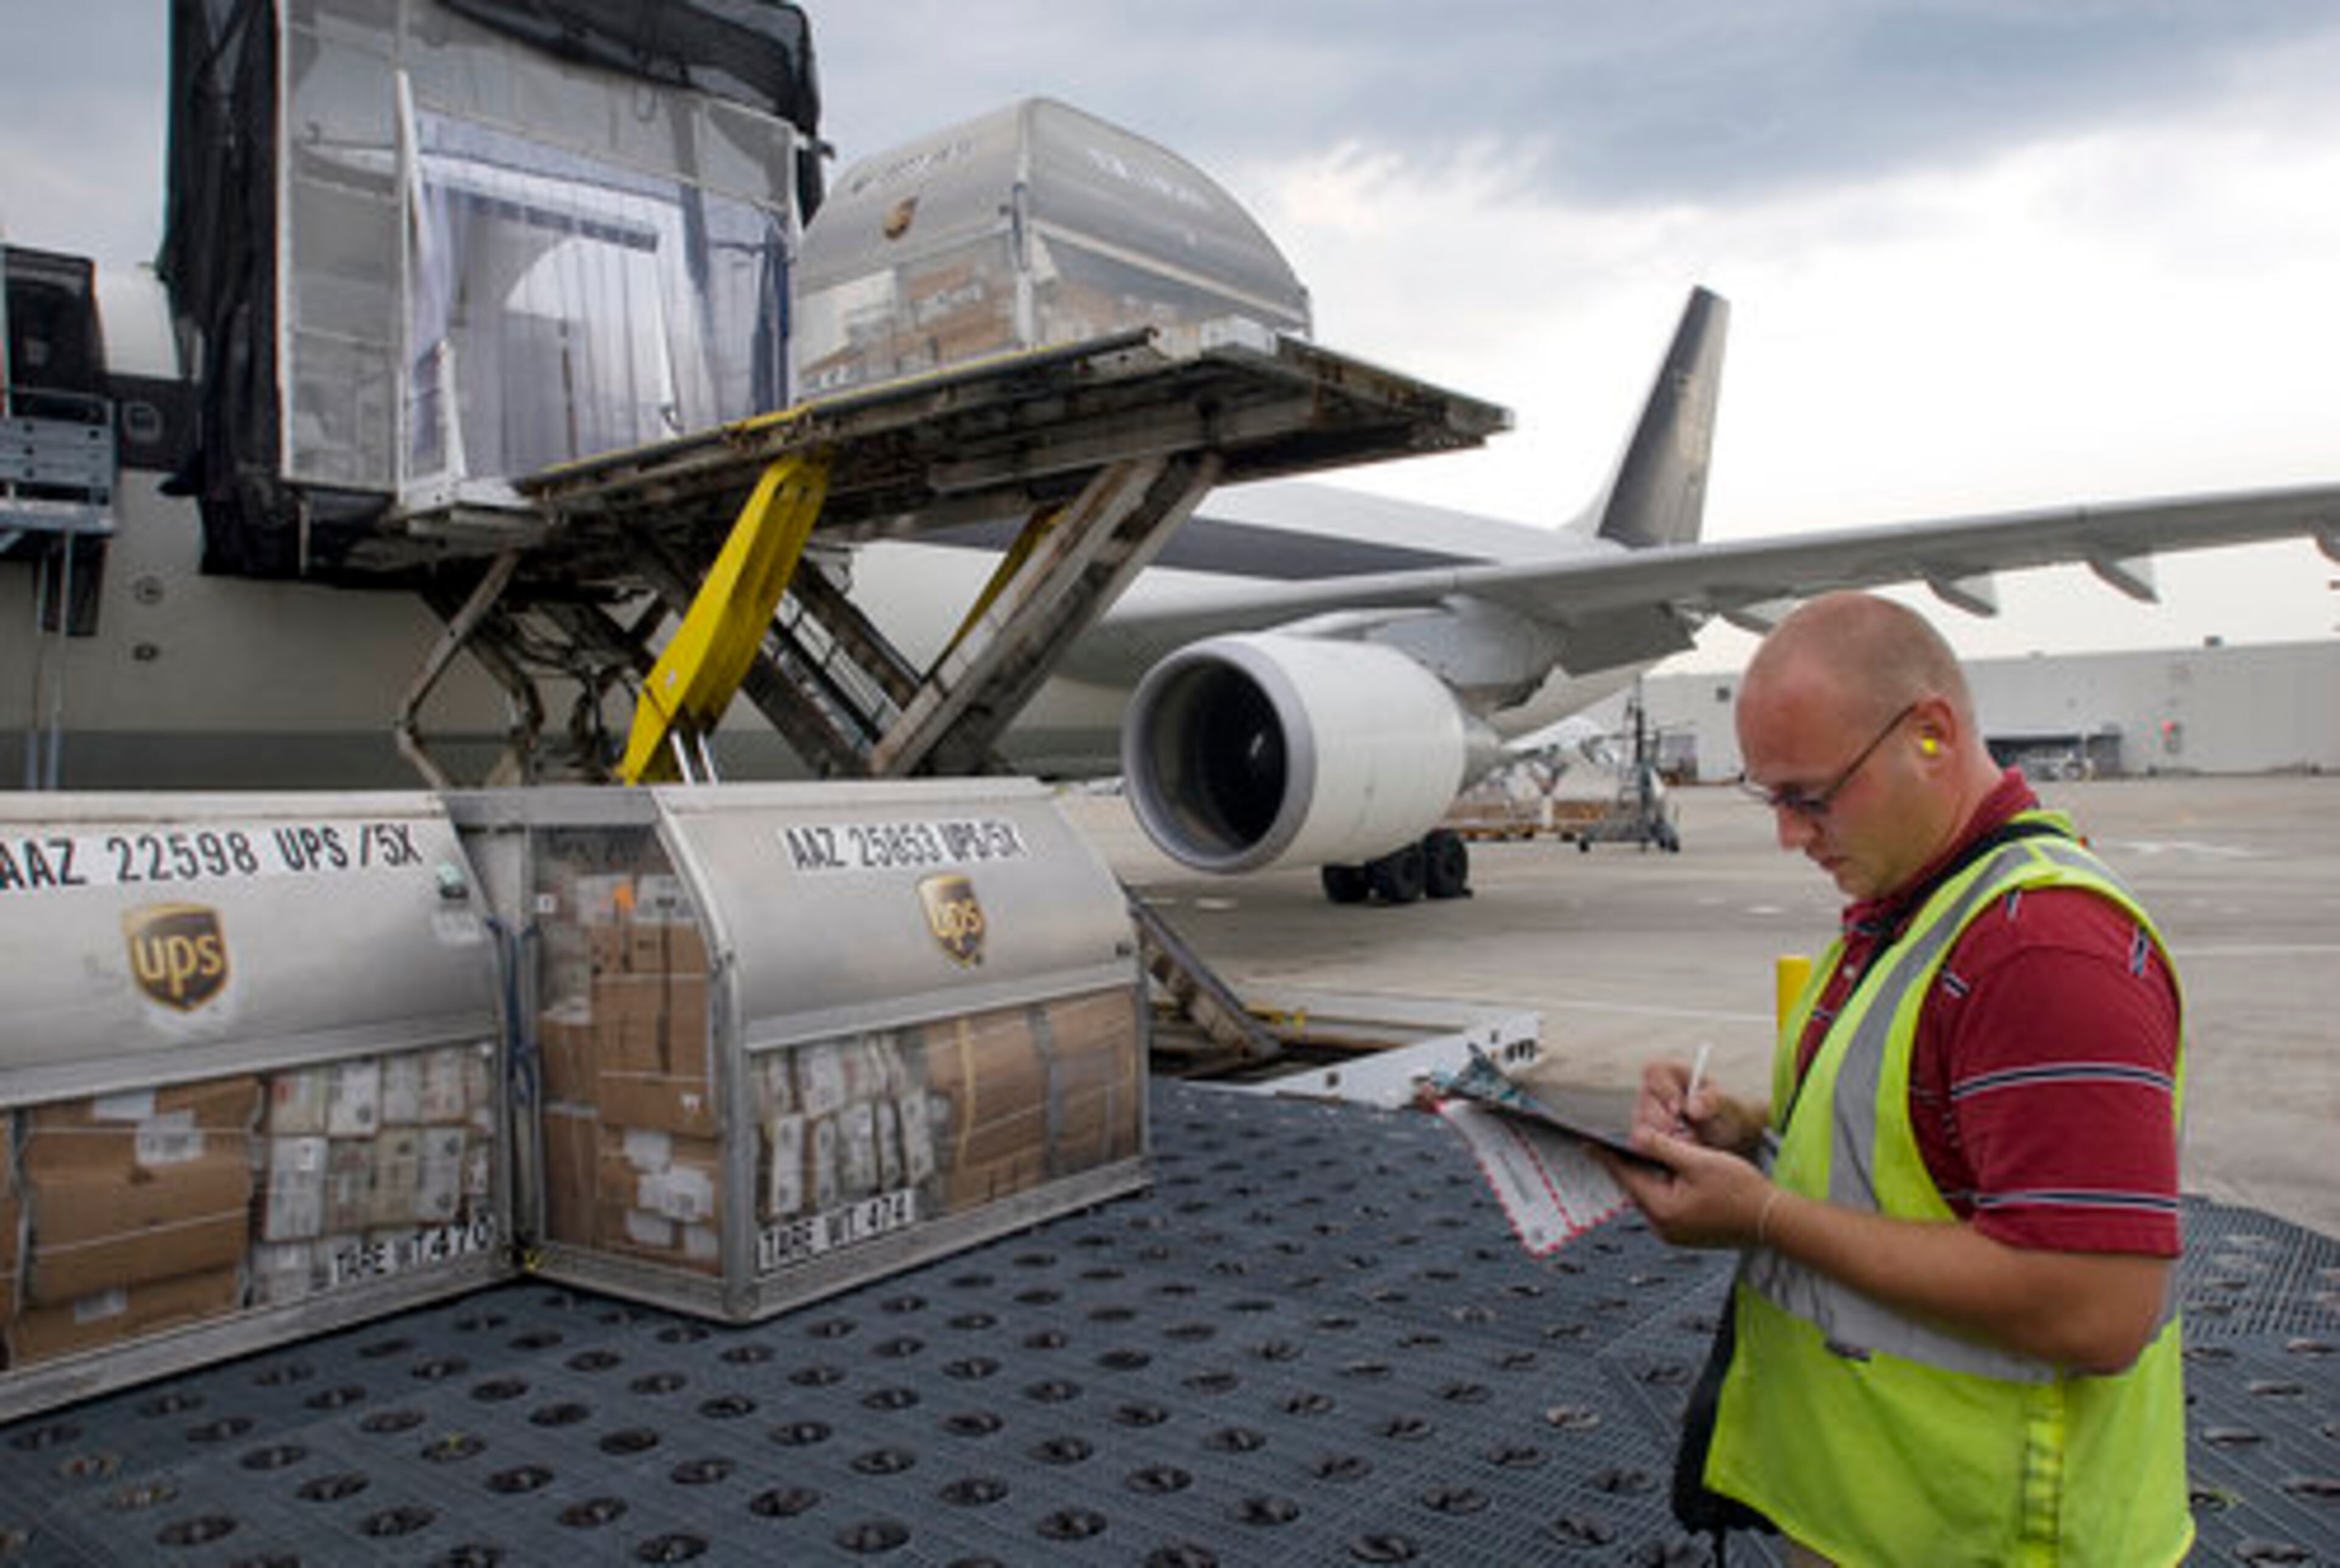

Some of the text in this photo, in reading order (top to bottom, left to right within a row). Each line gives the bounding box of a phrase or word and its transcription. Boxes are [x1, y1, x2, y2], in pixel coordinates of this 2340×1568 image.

[0, 838, 87, 890] AAZ
[106, 831, 259, 881] 22598
[274, 826, 349, 871] UPS
[133, 934, 224, 996] ups
